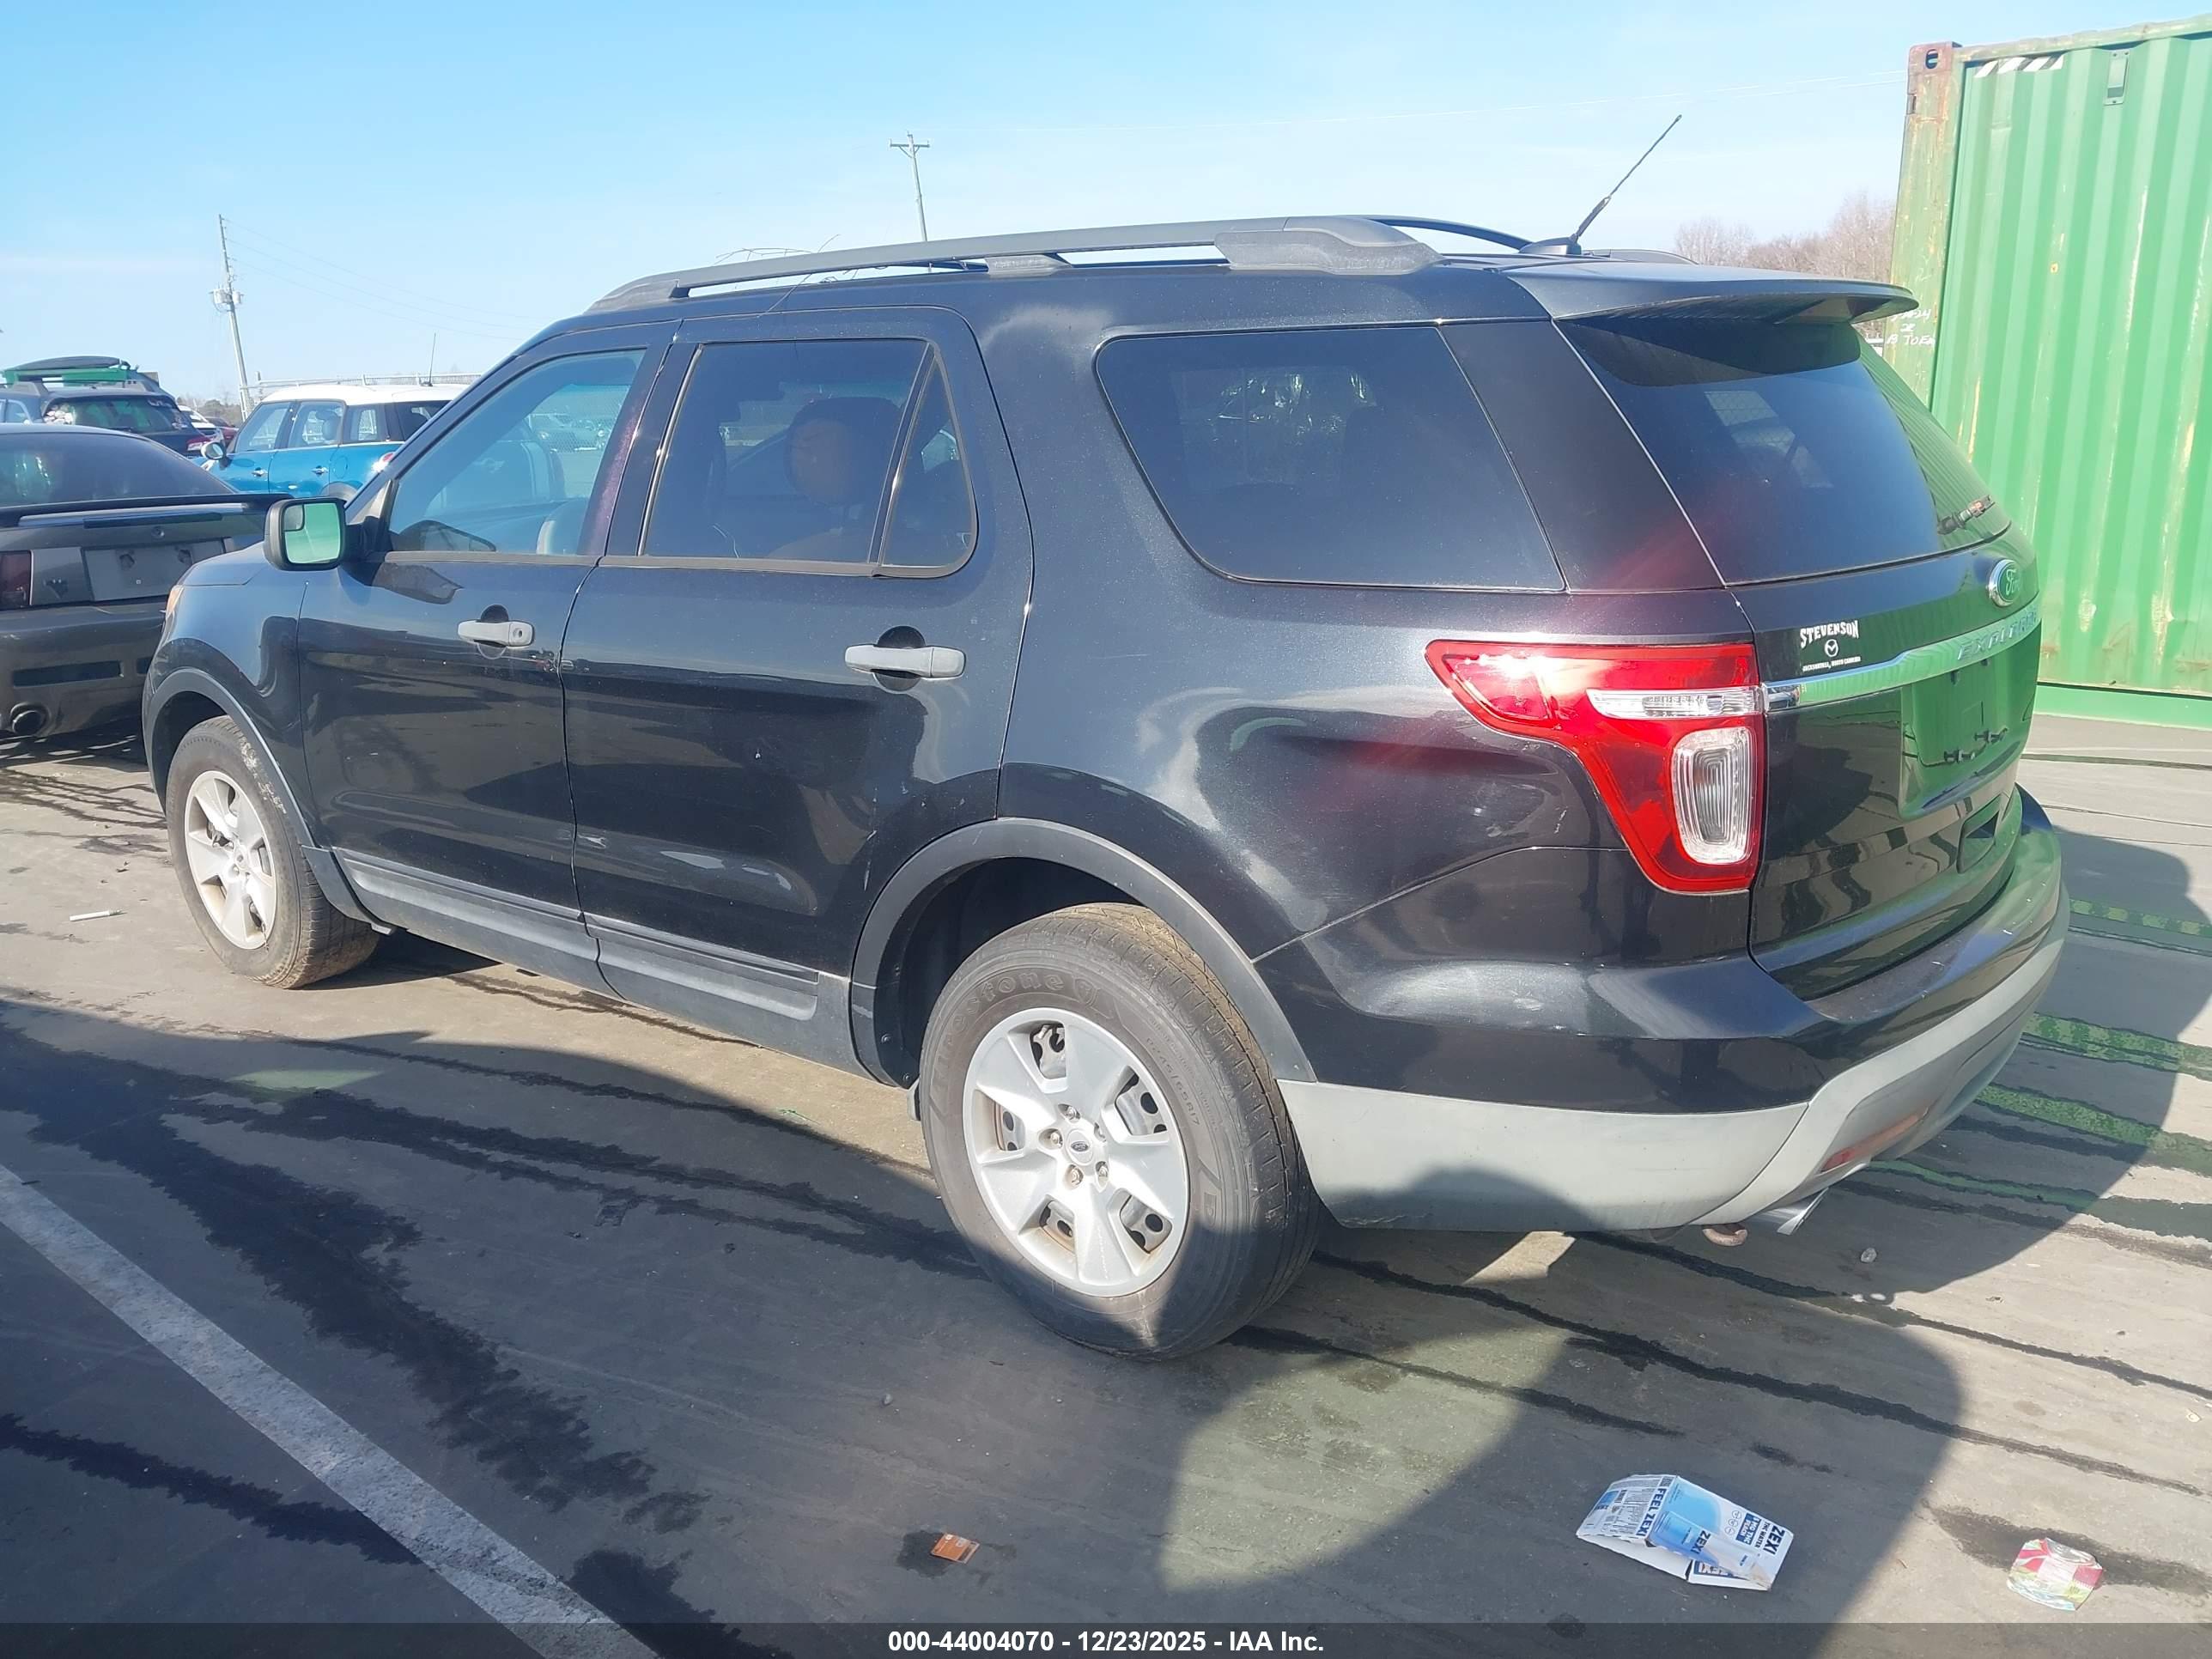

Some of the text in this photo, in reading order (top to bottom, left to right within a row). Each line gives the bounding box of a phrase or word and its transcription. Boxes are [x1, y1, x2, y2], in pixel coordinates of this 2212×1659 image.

[1800, 619, 1859, 649] STEVENSON
[1636, 1488, 1667, 1536] FEEL ZEXI
[1691, 1530, 1711, 1554] ZEXI
[1754, 1532, 1765, 1548] WATER
[1763, 1526, 1785, 1554] ZEXI
